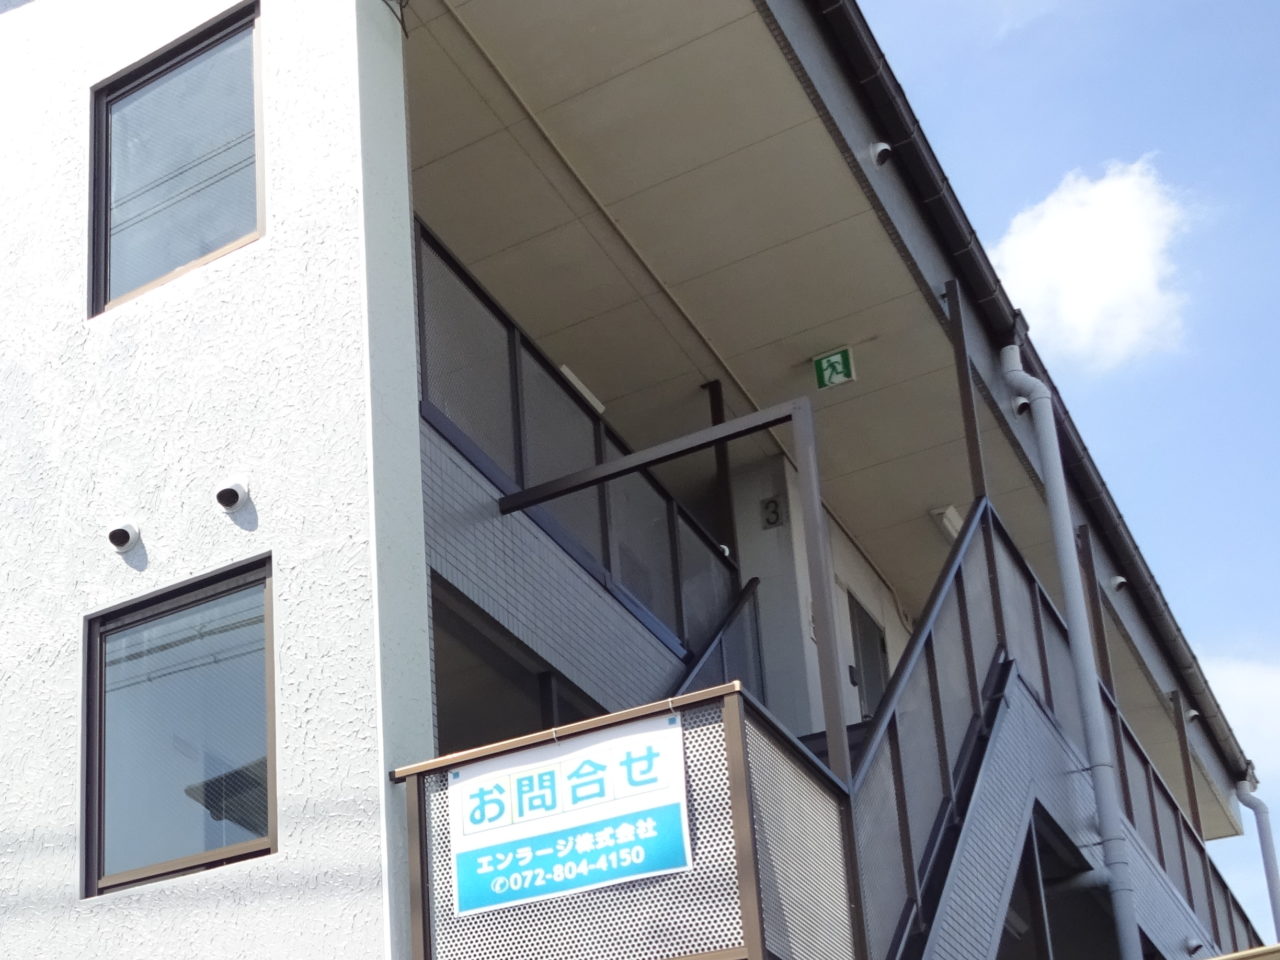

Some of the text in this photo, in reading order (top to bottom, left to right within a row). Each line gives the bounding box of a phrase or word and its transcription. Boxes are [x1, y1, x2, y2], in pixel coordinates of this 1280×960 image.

[765, 499, 780, 526] 3
[469, 745, 661, 825] お問合せ
[476, 817, 658, 875] エンラージ株式会社
